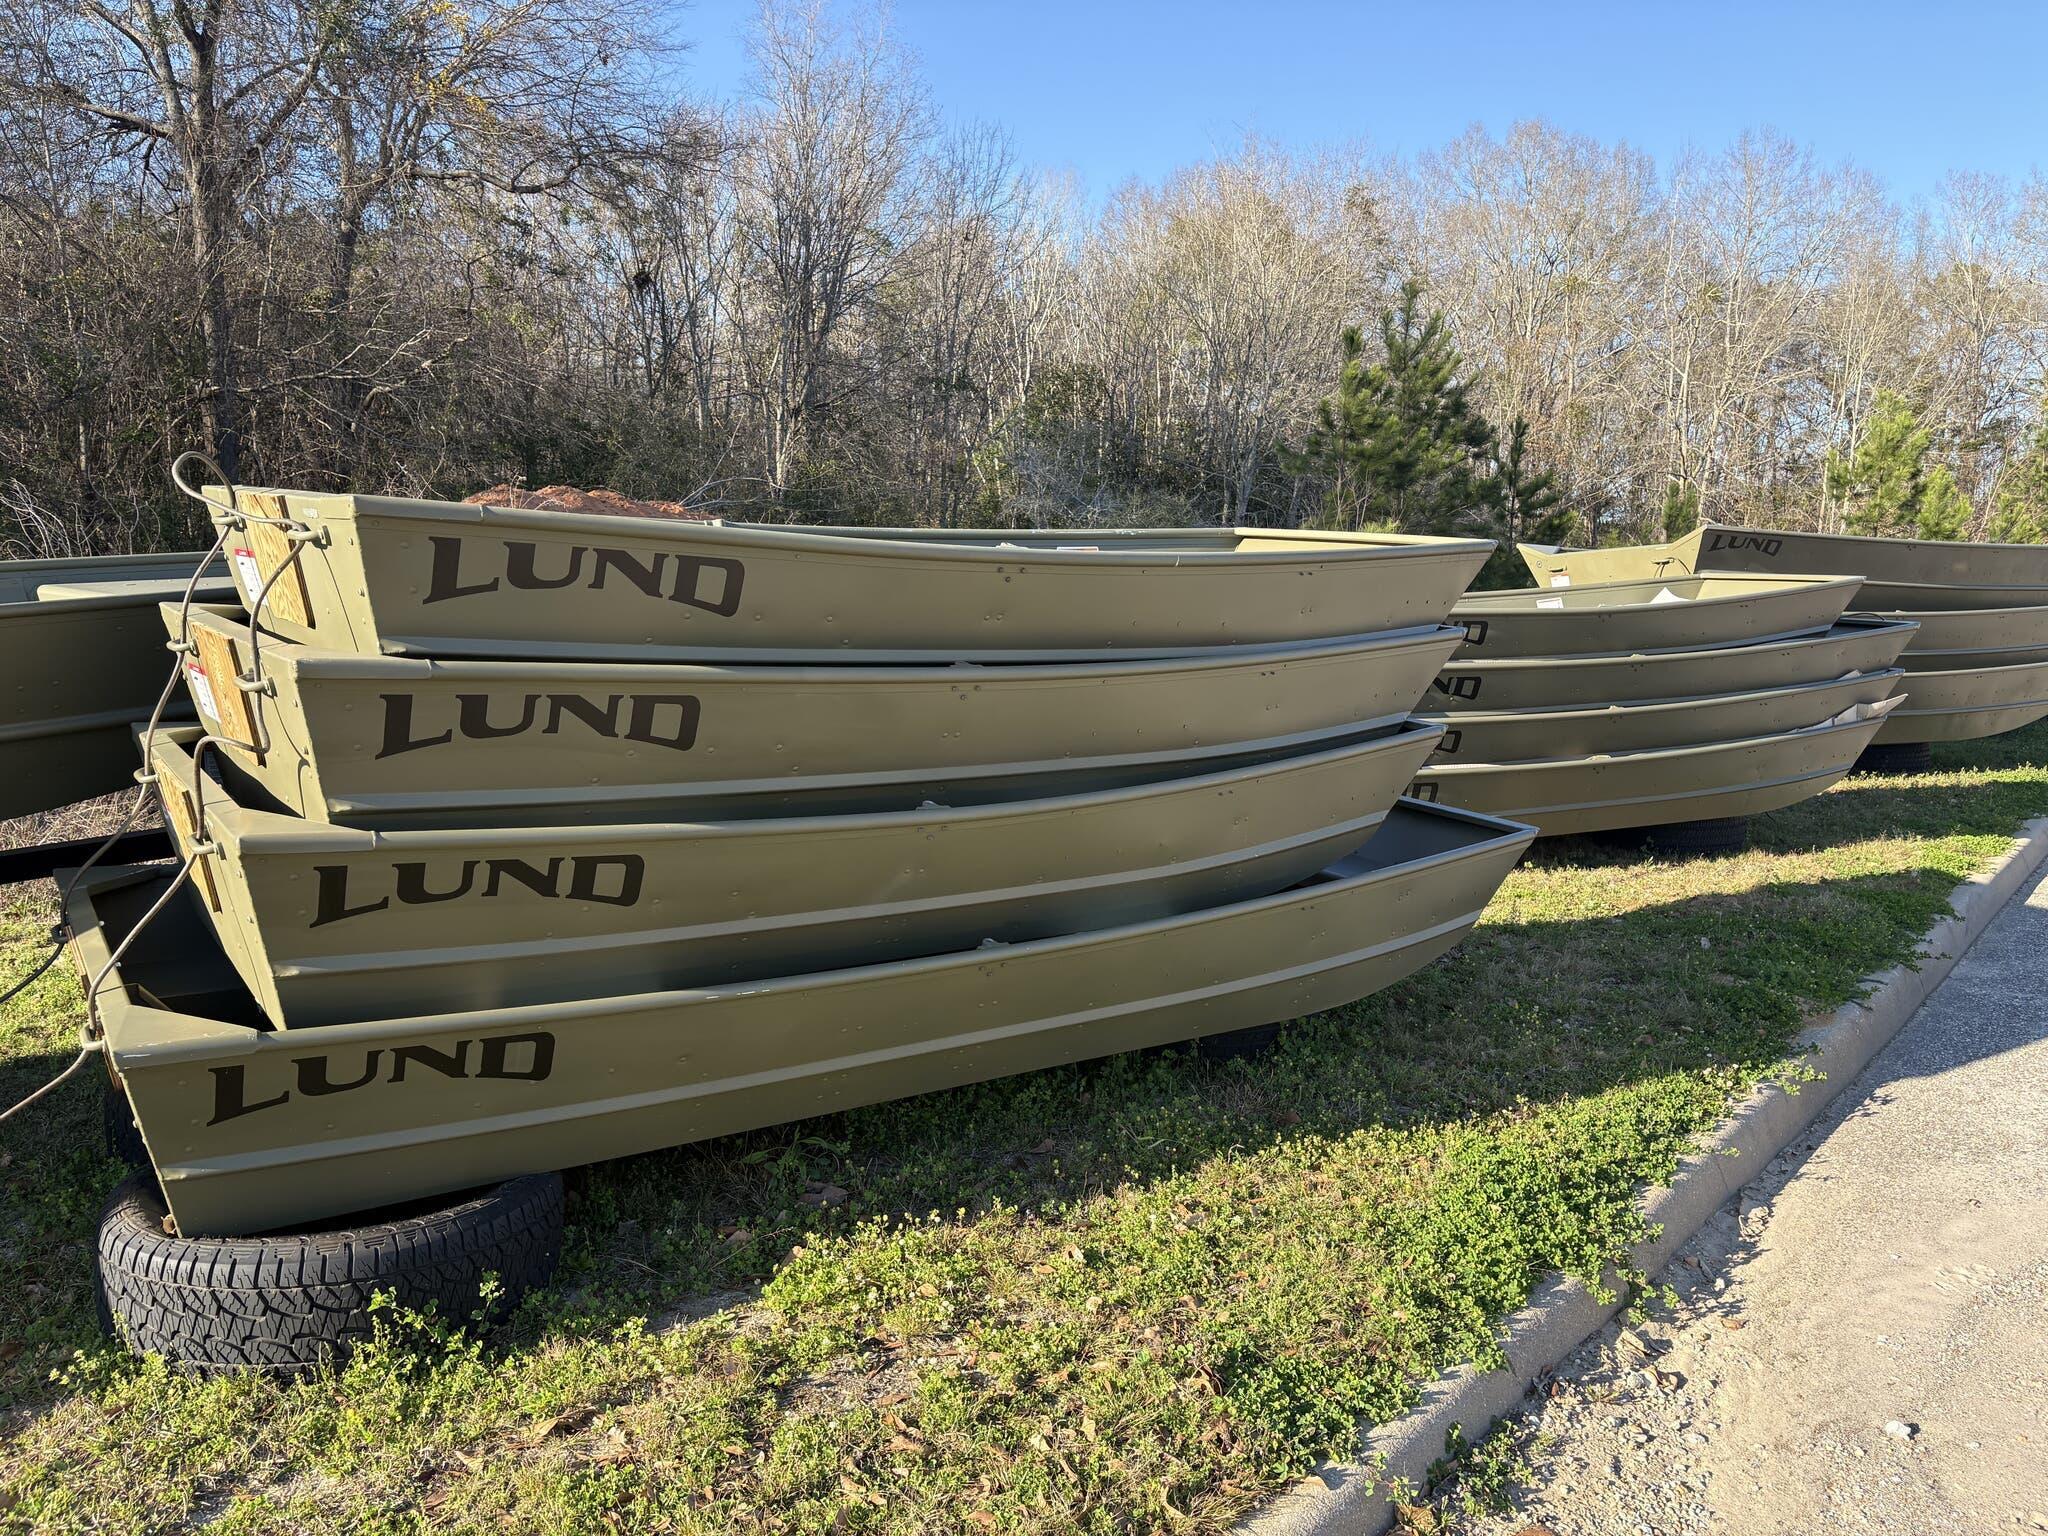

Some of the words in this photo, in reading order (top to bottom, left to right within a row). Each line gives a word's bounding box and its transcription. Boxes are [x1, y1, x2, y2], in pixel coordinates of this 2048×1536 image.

[423, 536, 745, 617] LUND
[1708, 534, 1783, 557] LUND
[375, 694, 700, 760] LUND
[309, 855, 644, 928] LUND
[206, 1032, 555, 1127] LUND
